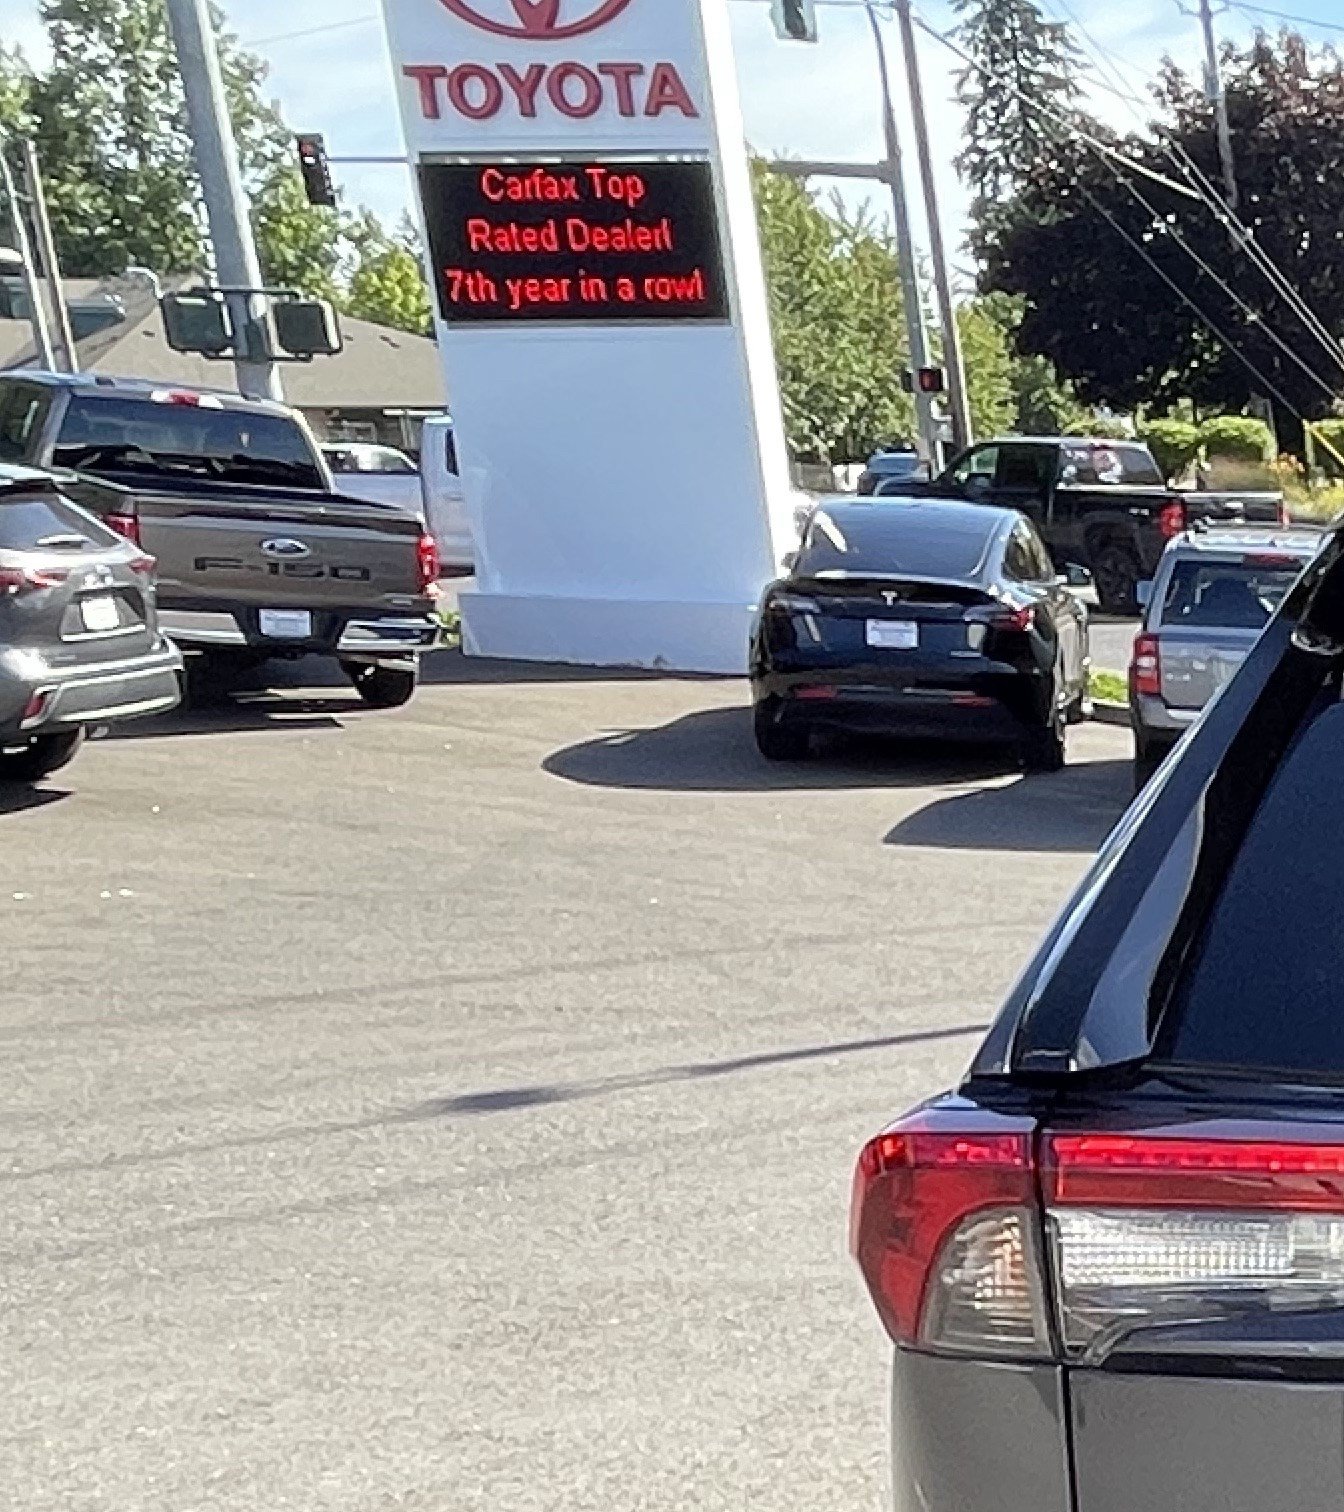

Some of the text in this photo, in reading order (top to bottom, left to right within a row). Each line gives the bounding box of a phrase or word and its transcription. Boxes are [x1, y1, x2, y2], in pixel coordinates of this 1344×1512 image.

[402, 61, 701, 120] TOYOTA
[481, 167, 646, 208] Carfax Top
[466, 217, 674, 252] Rated Dealer!
[444, 267, 706, 310] 7th year in a row!
[193, 556, 370, 582] F-150
